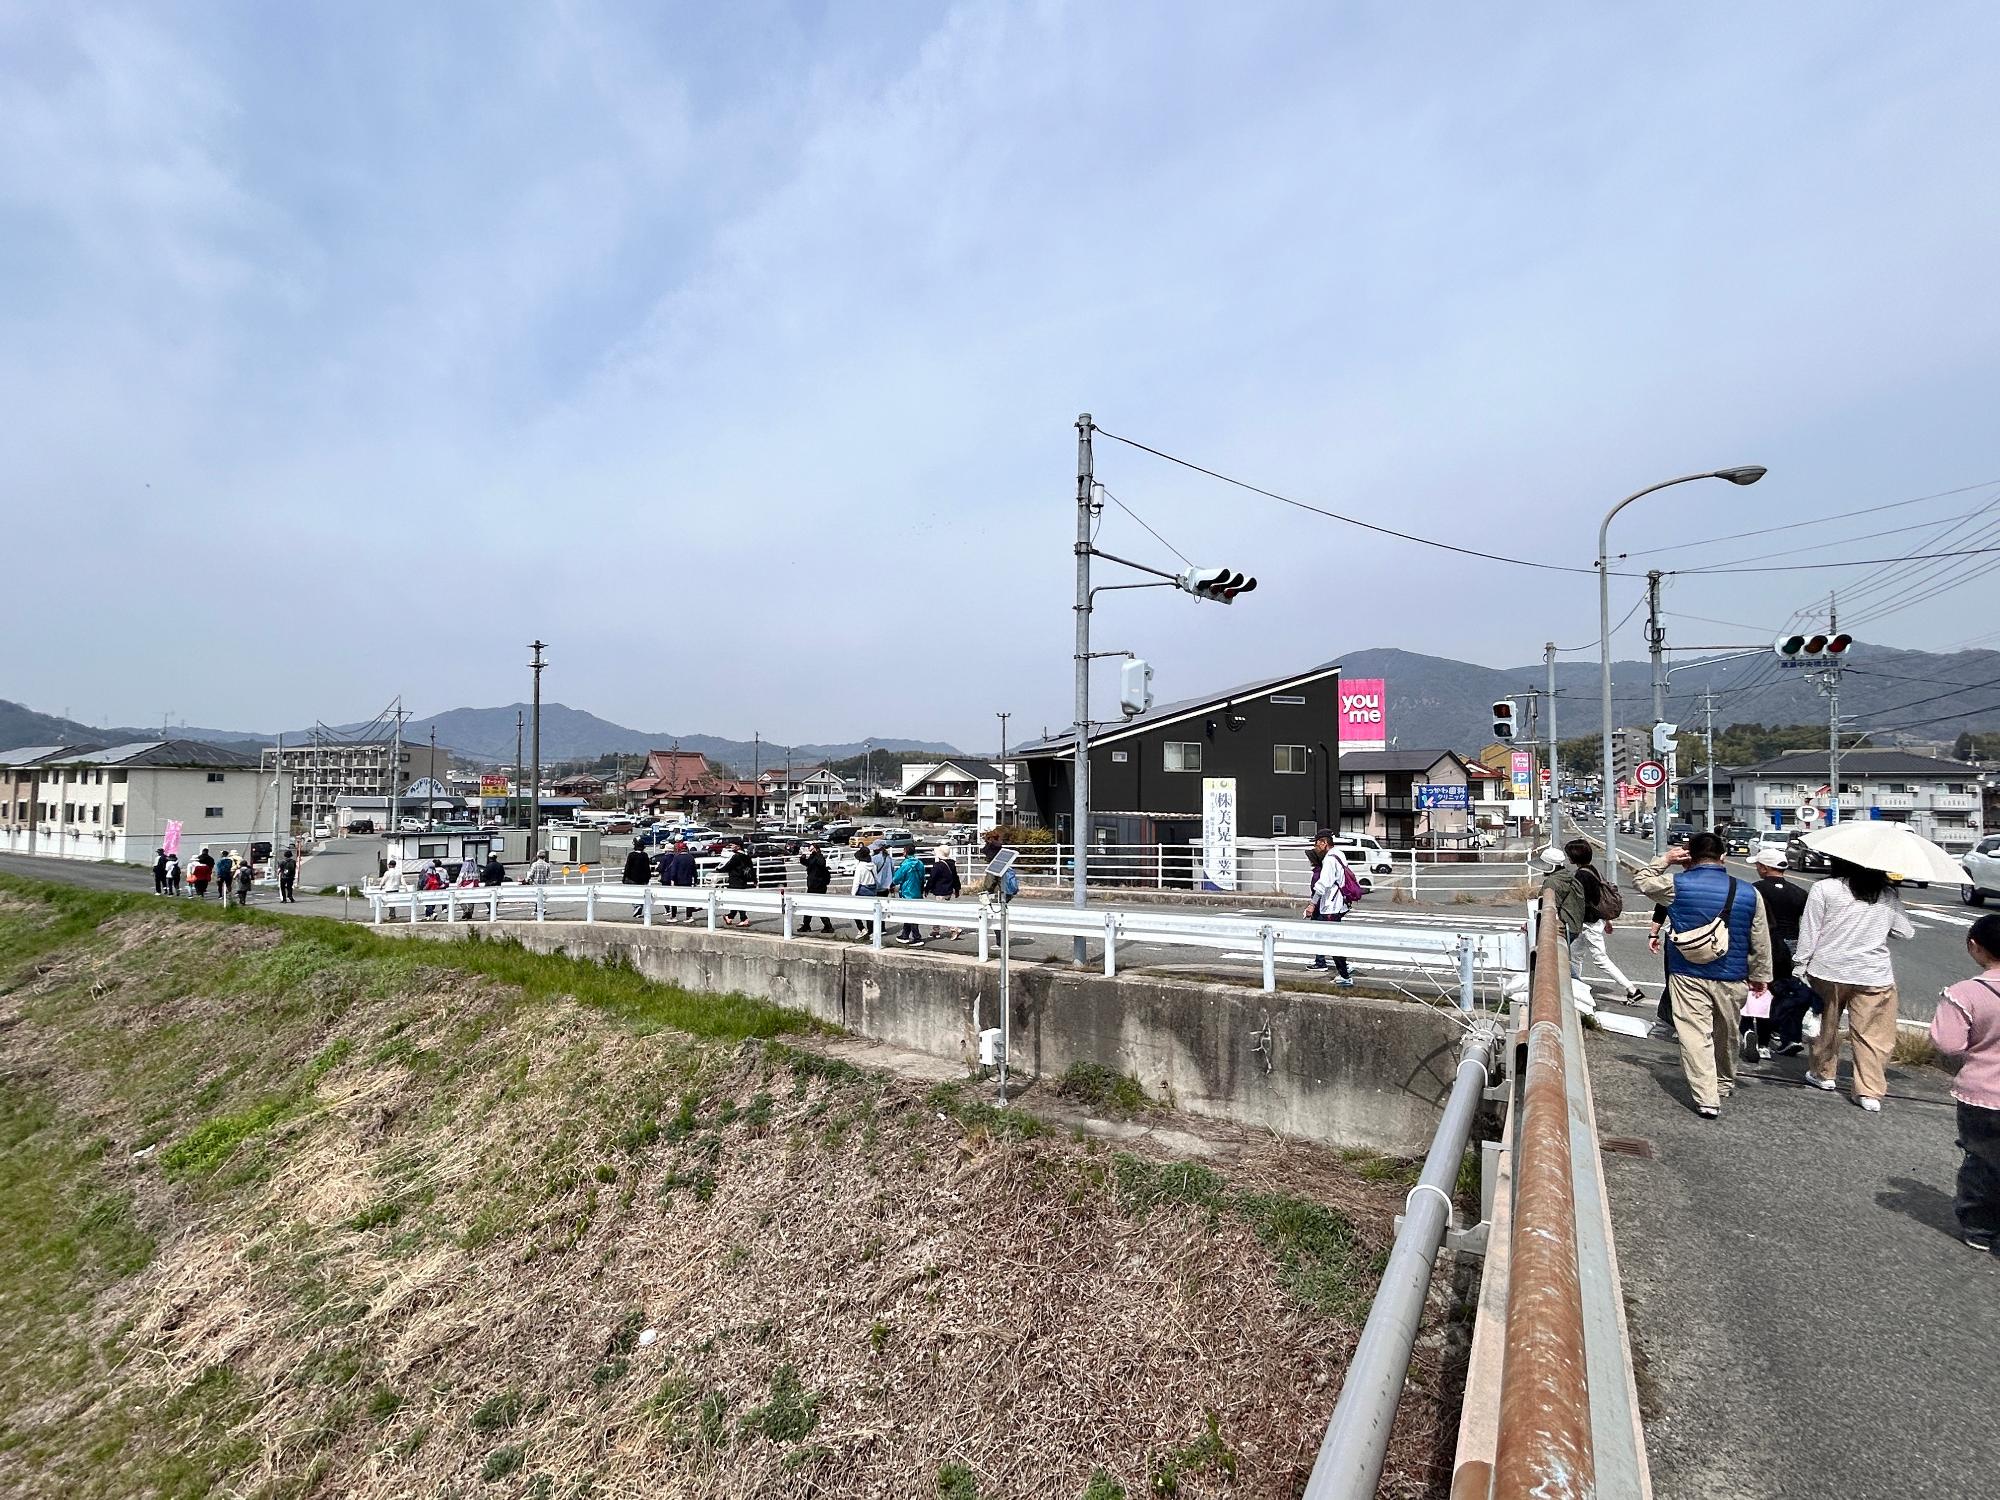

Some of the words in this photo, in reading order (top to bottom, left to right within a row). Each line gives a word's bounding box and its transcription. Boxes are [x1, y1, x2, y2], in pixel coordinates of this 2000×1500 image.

[1341, 694, 1379, 714] you
[1349, 709, 1382, 723] me
[1514, 756, 1529, 766] you
[1642, 768, 1660, 781] 50
[1421, 786, 1466, 795] きっかわ歯科
[1802, 807, 1815, 819] P
